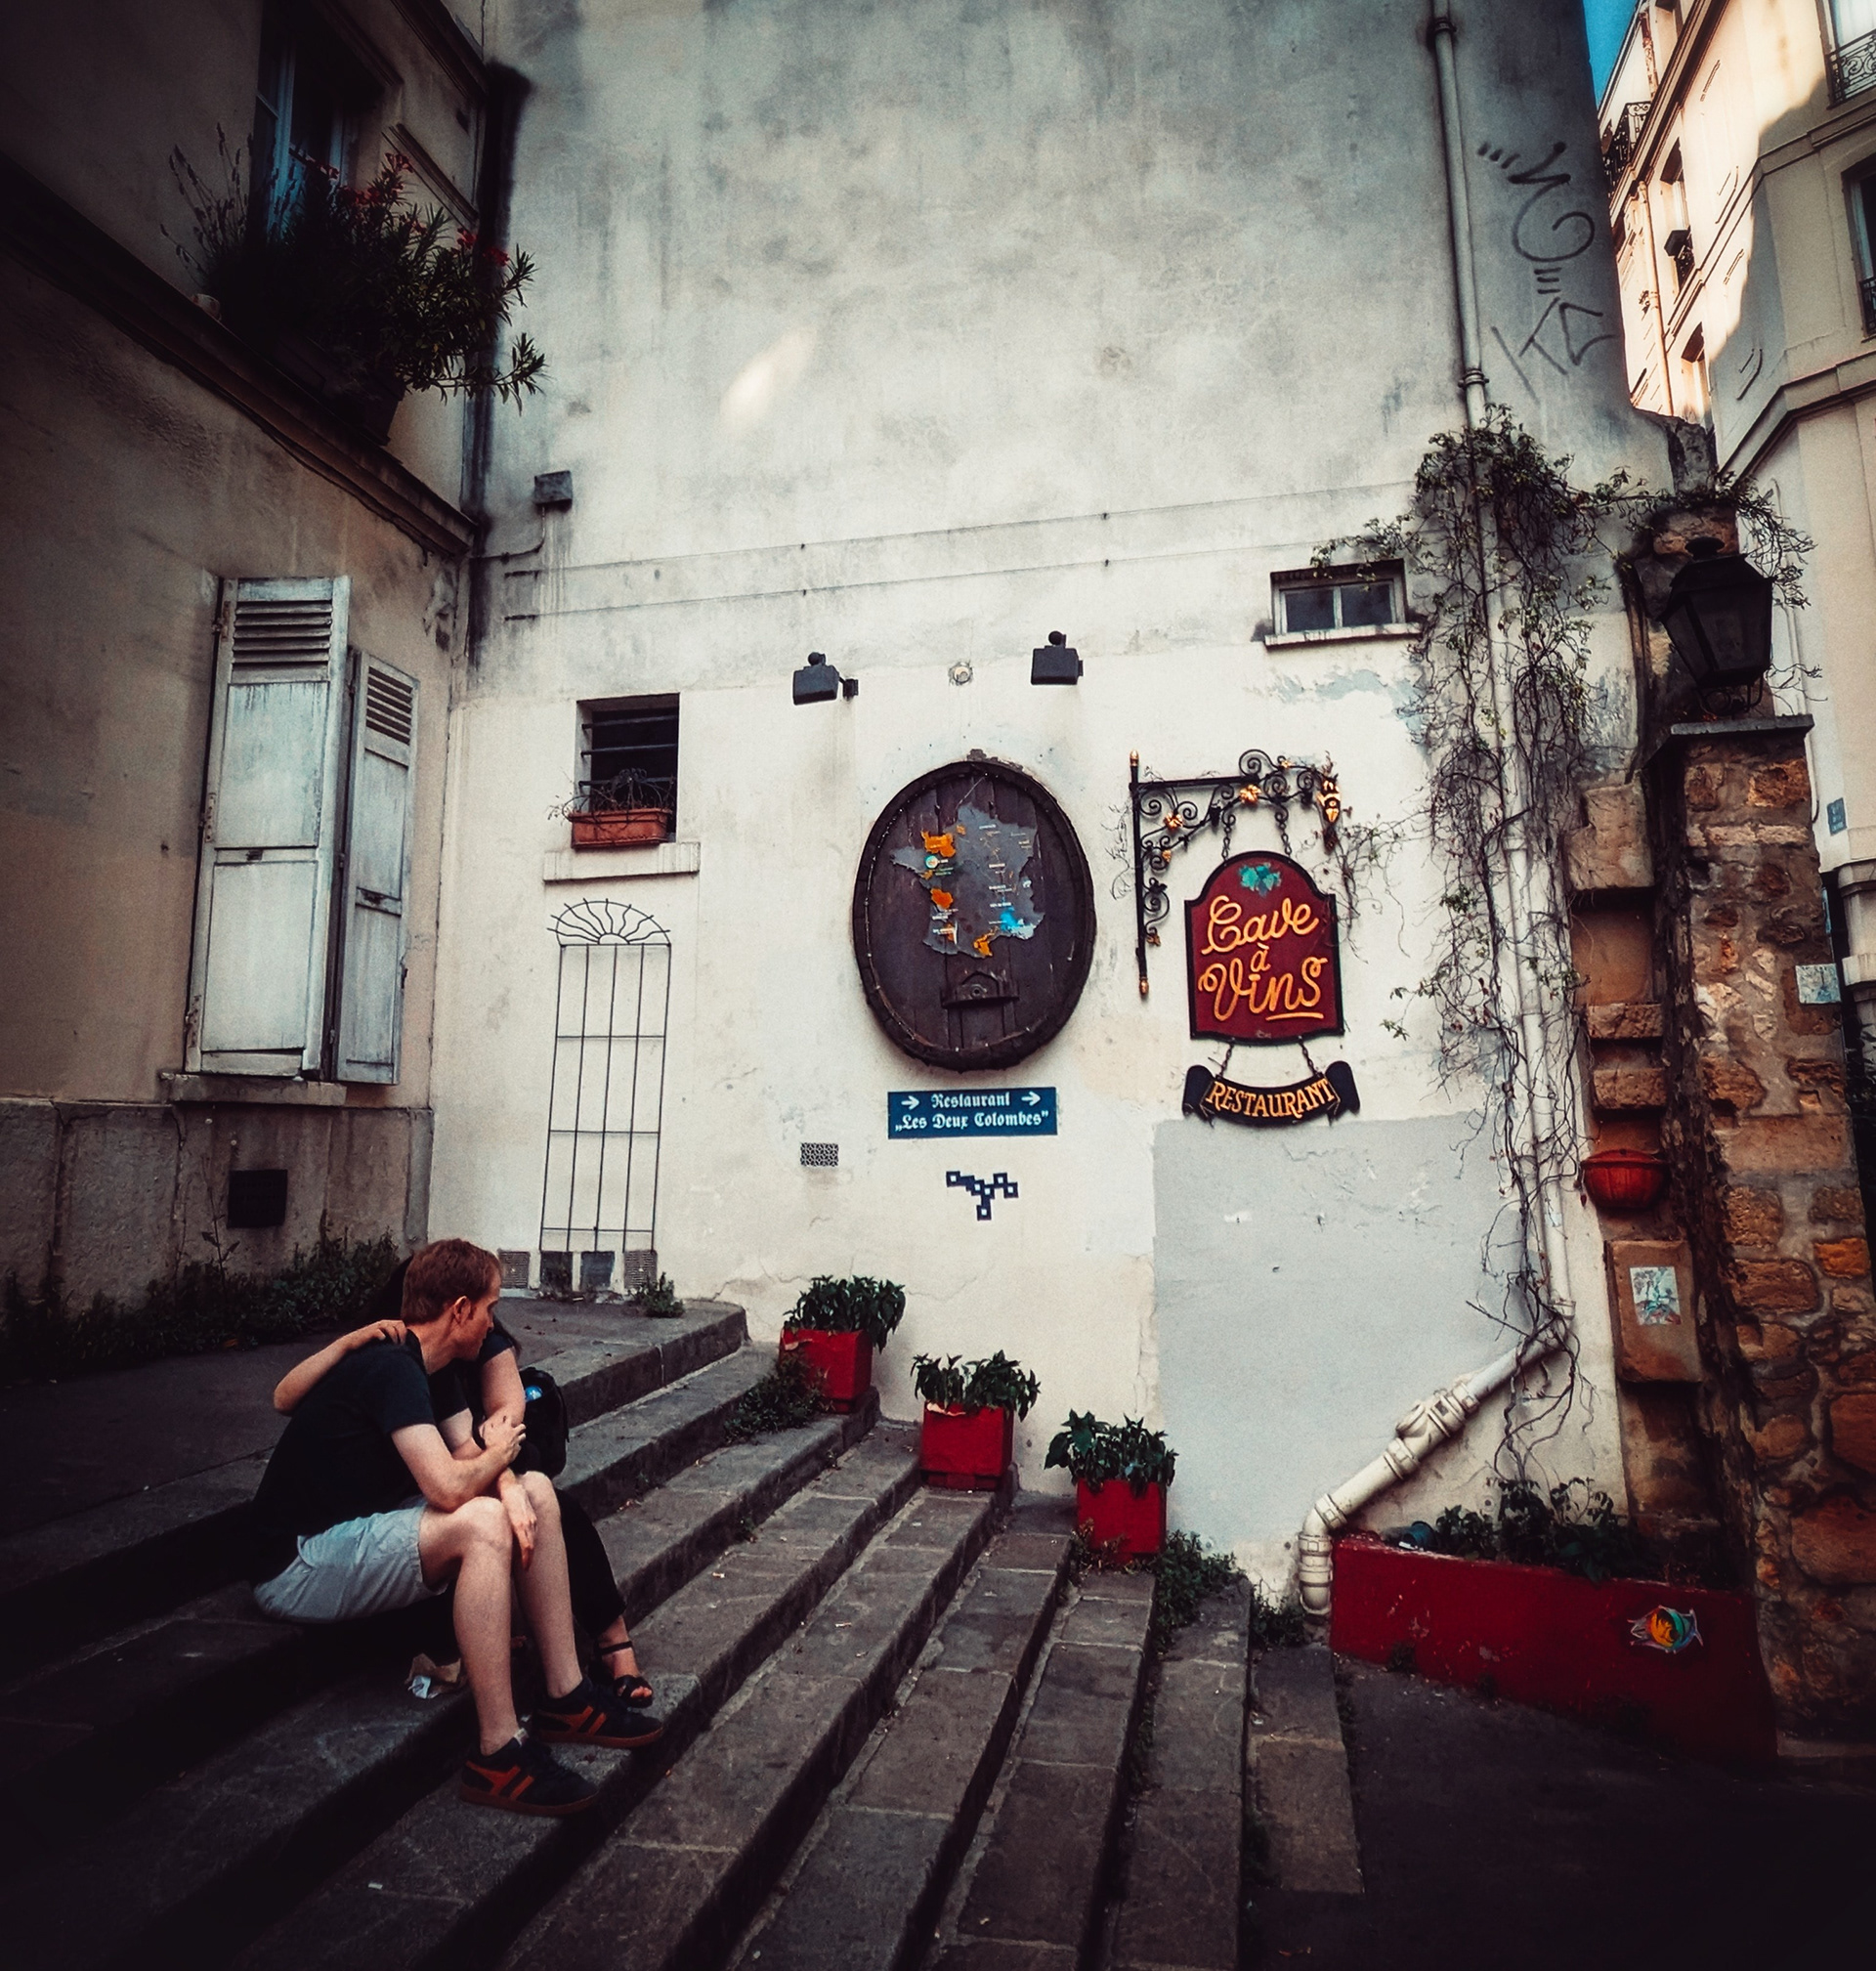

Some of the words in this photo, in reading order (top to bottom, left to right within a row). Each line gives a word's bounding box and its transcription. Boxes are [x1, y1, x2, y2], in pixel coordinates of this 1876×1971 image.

[1201, 895, 1319, 955] Cave
[1251, 943, 1270, 972] à
[1198, 958, 1328, 1021] Vins
[931, 1093, 1010, 1109] Restaurant
[1206, 1078, 1336, 1119] RESTAURANT
[932, 1113, 968, 1130] Deux
